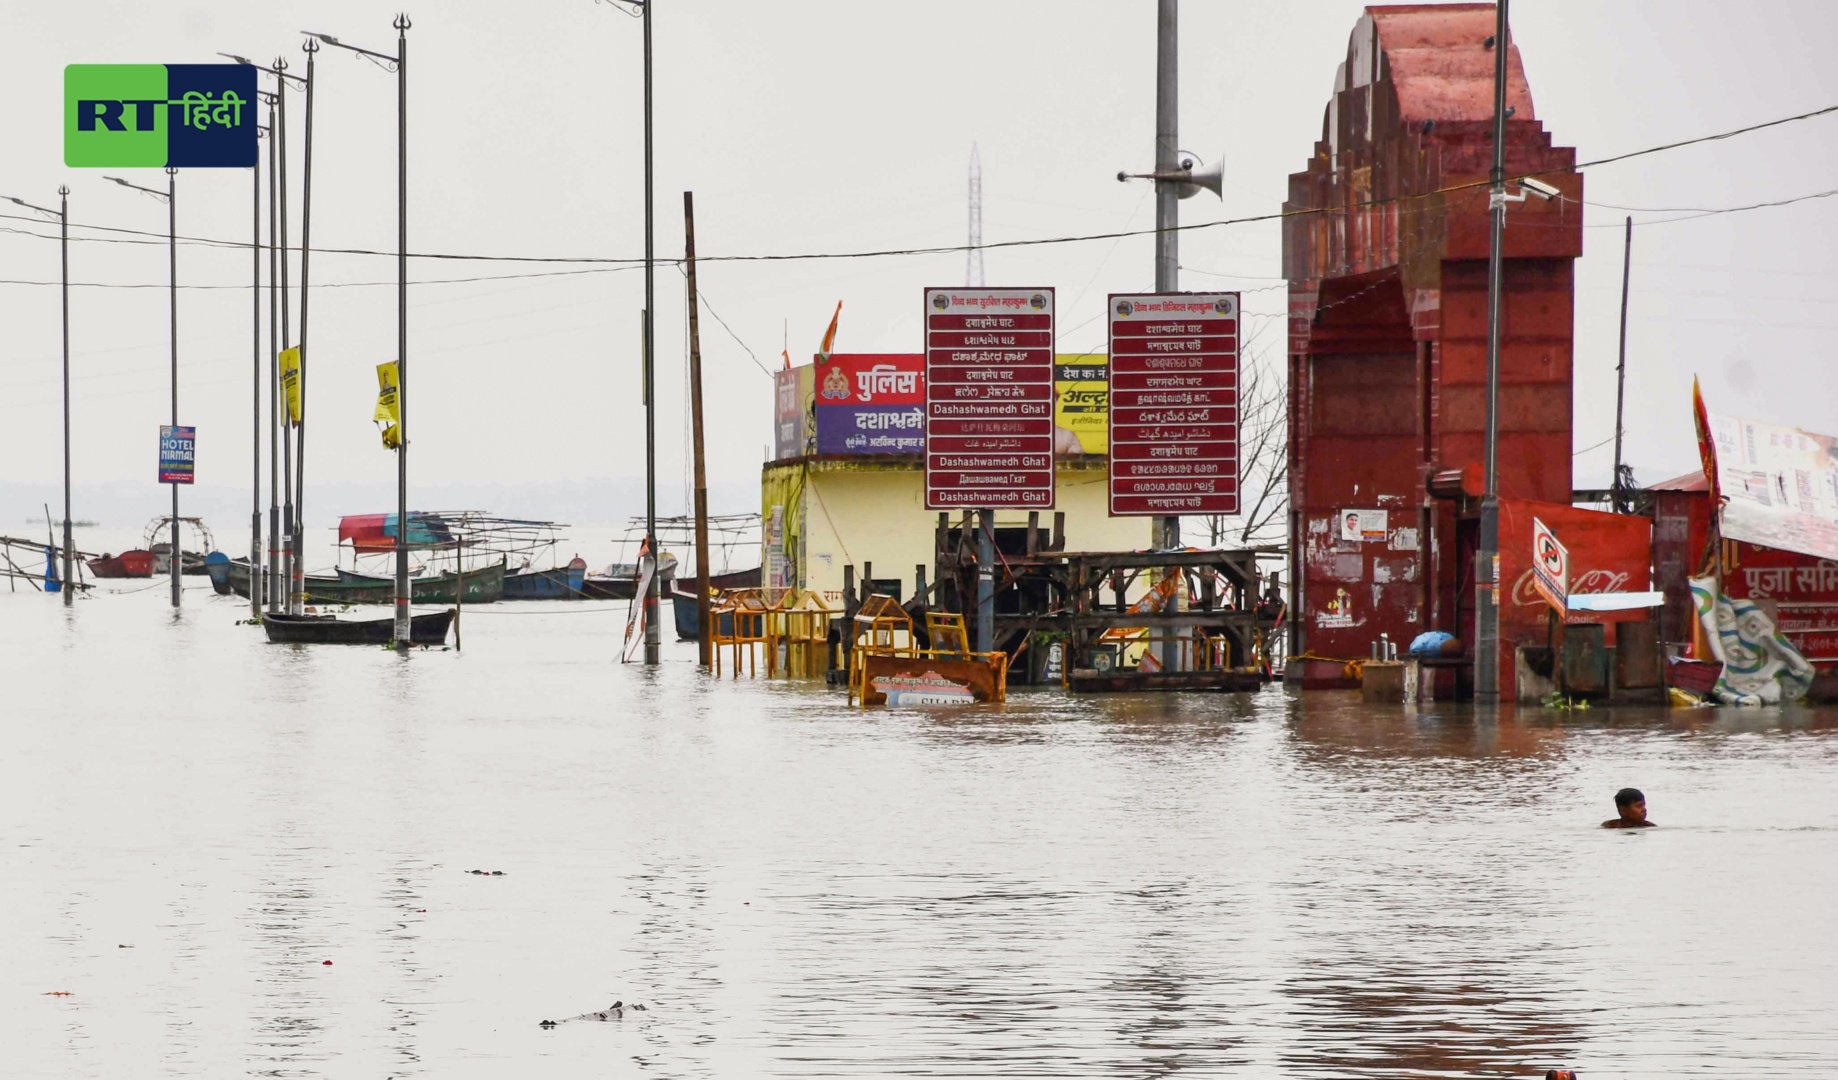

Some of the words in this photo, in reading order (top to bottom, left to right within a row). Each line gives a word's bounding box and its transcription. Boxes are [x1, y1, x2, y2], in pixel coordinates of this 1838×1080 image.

[1063, 366, 1079, 380] देश
[1082, 369, 1094, 379] का
[856, 364, 918, 402] पुलिस
[934, 404, 1018, 414] Dashashwamedh
[1021, 404, 1046, 414] Ghat
[162, 440, 194, 450] HOTEL
[897, 438, 918, 450] कुमार
[161, 450, 194, 460] NIRMAL
[940, 456, 1018, 466] Dashashwamedh
[1022, 456, 1046, 466] Ghat
[940, 492, 1018, 502] Dashashwamedh
[1022, 492, 1046, 502] Ghat
[1743, 567, 1794, 598] पूजा
